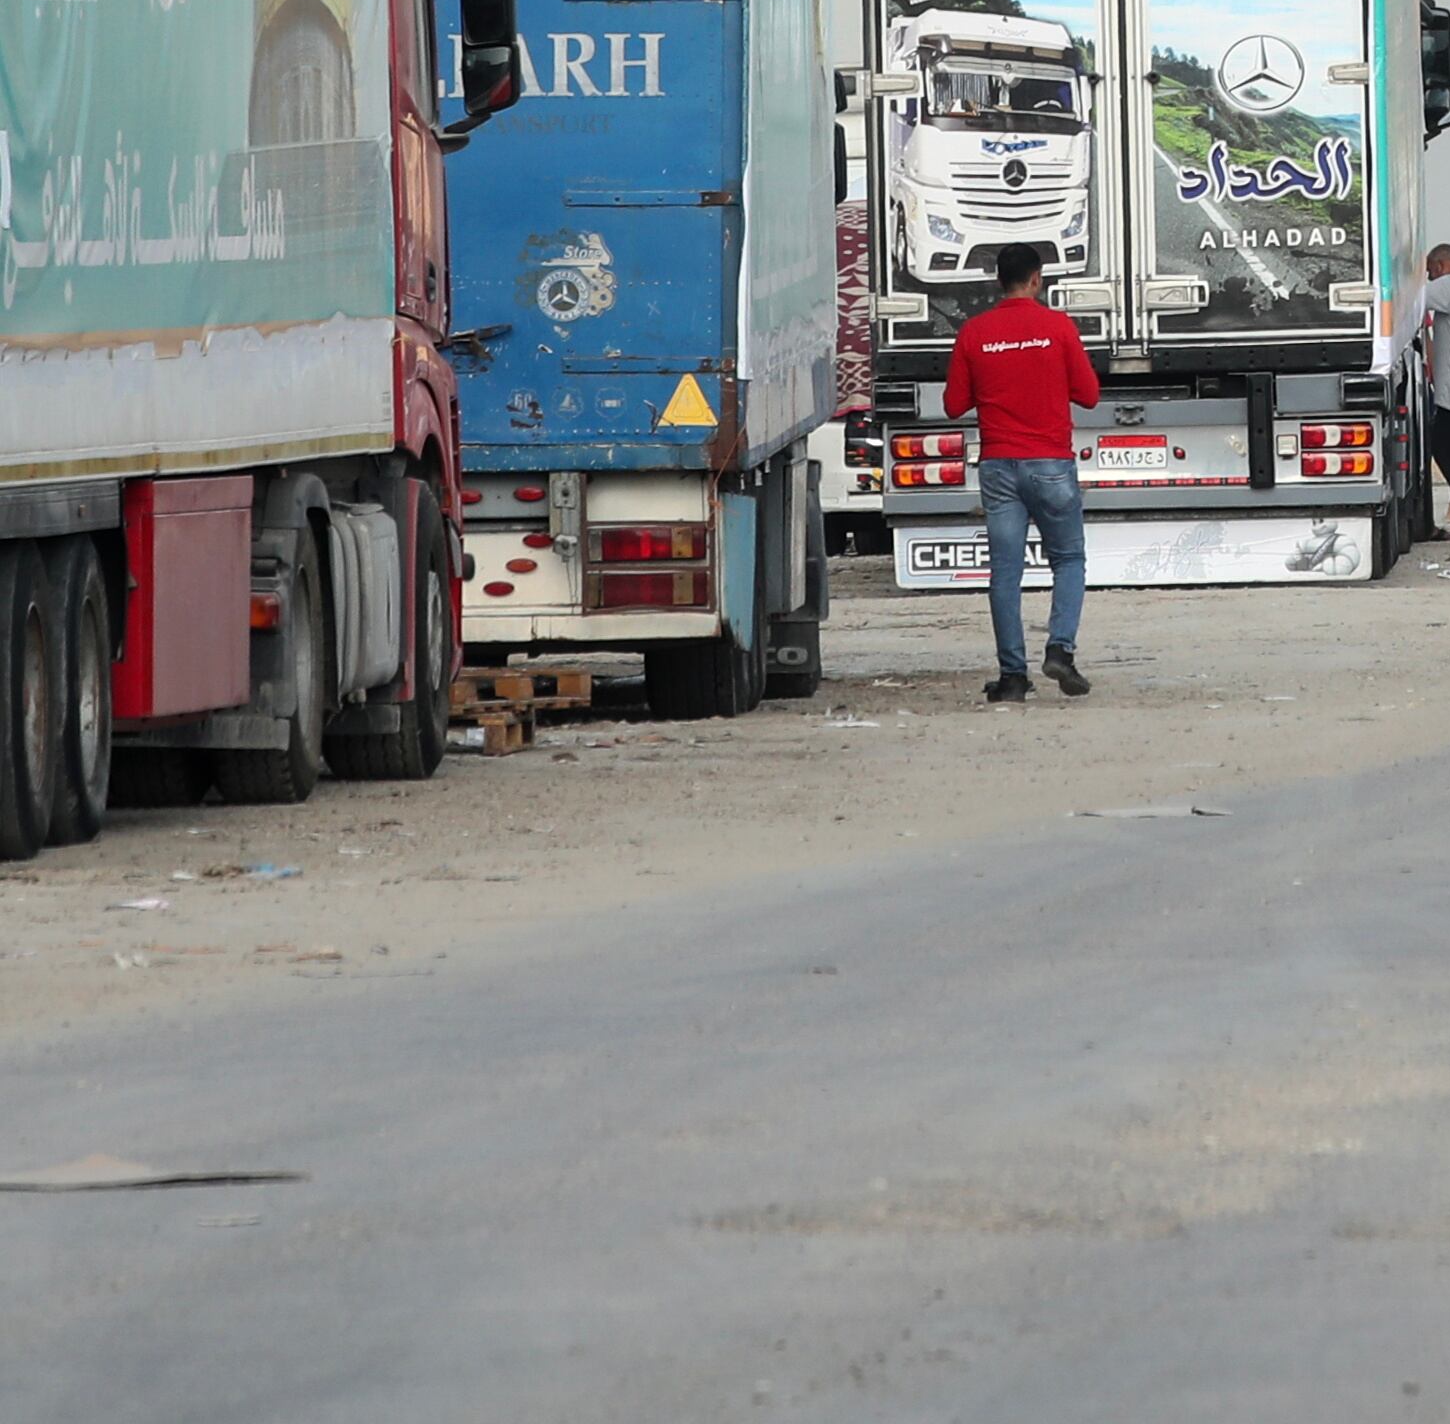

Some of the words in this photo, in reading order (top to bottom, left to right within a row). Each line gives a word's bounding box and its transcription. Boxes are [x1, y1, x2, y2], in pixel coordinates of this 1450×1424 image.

[1178, 137, 1351, 201] الحداد
[1199, 227, 1348, 249] ALHADAD
[564, 245, 603, 260] Store
